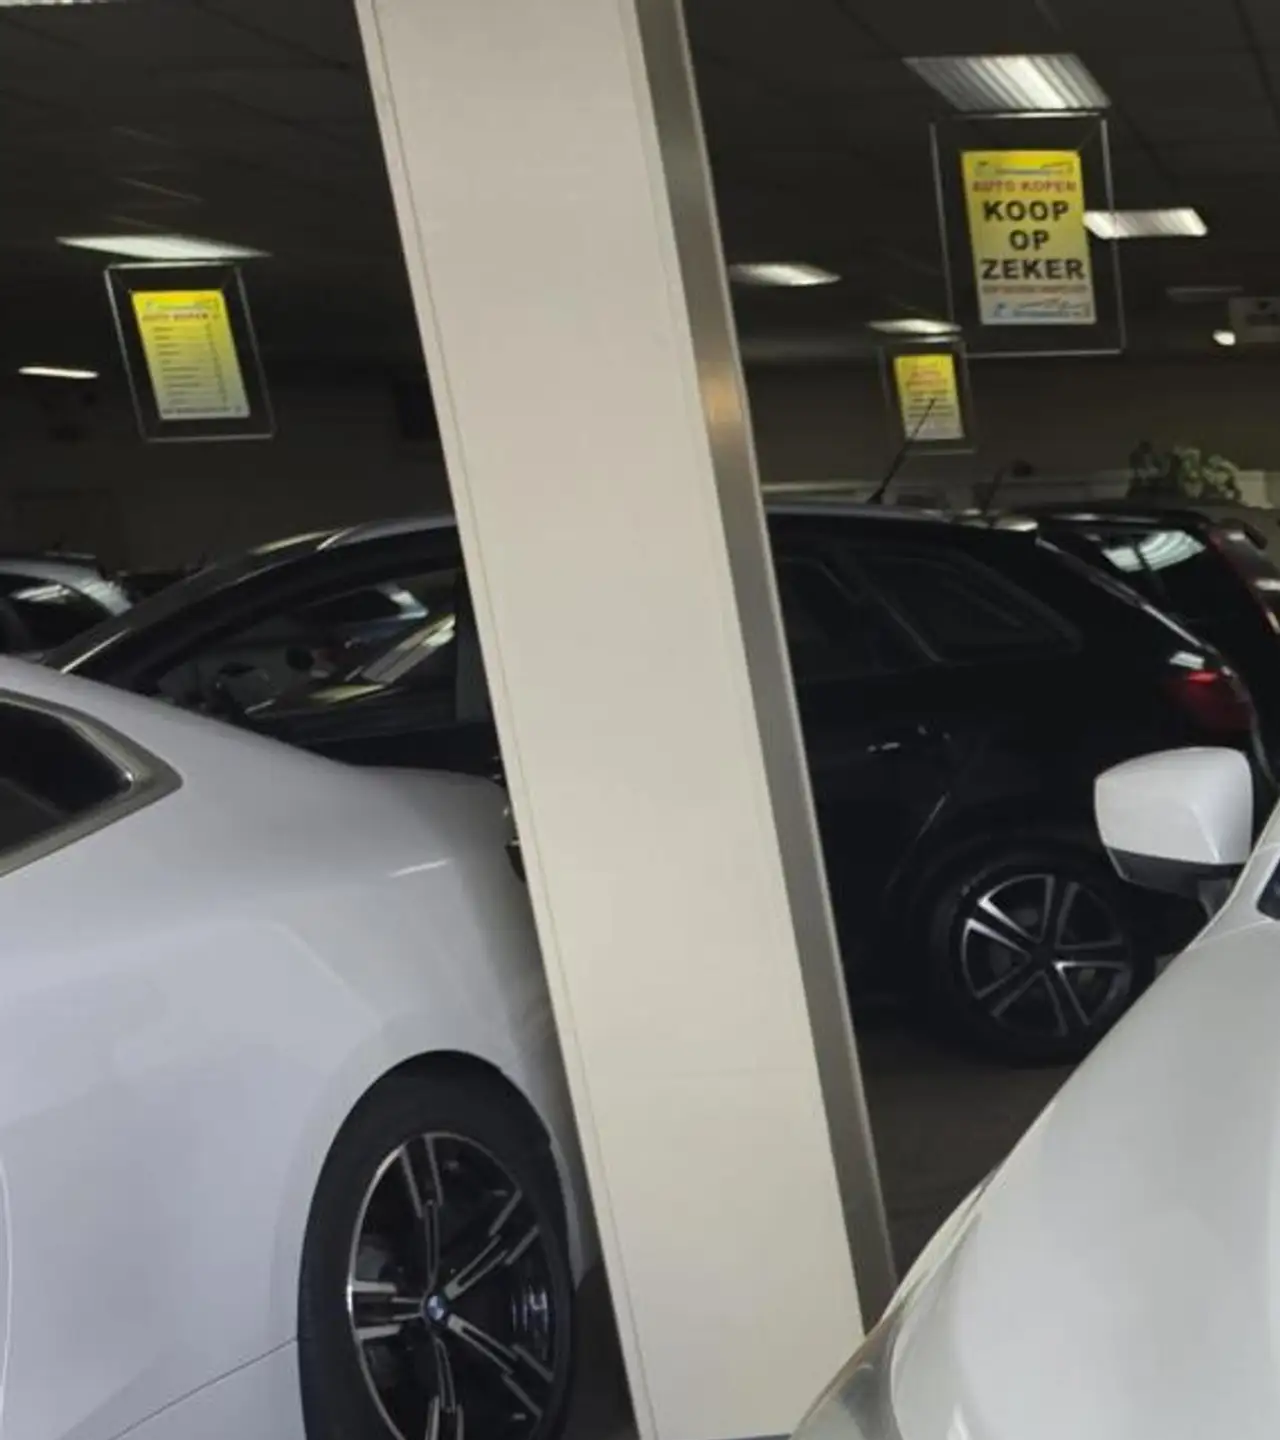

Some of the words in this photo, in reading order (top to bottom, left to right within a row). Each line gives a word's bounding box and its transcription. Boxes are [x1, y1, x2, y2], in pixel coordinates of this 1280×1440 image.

[982, 200, 1069, 221] KOOP
[1009, 229, 1050, 251] OP
[981, 259, 1085, 280] ZEKER
